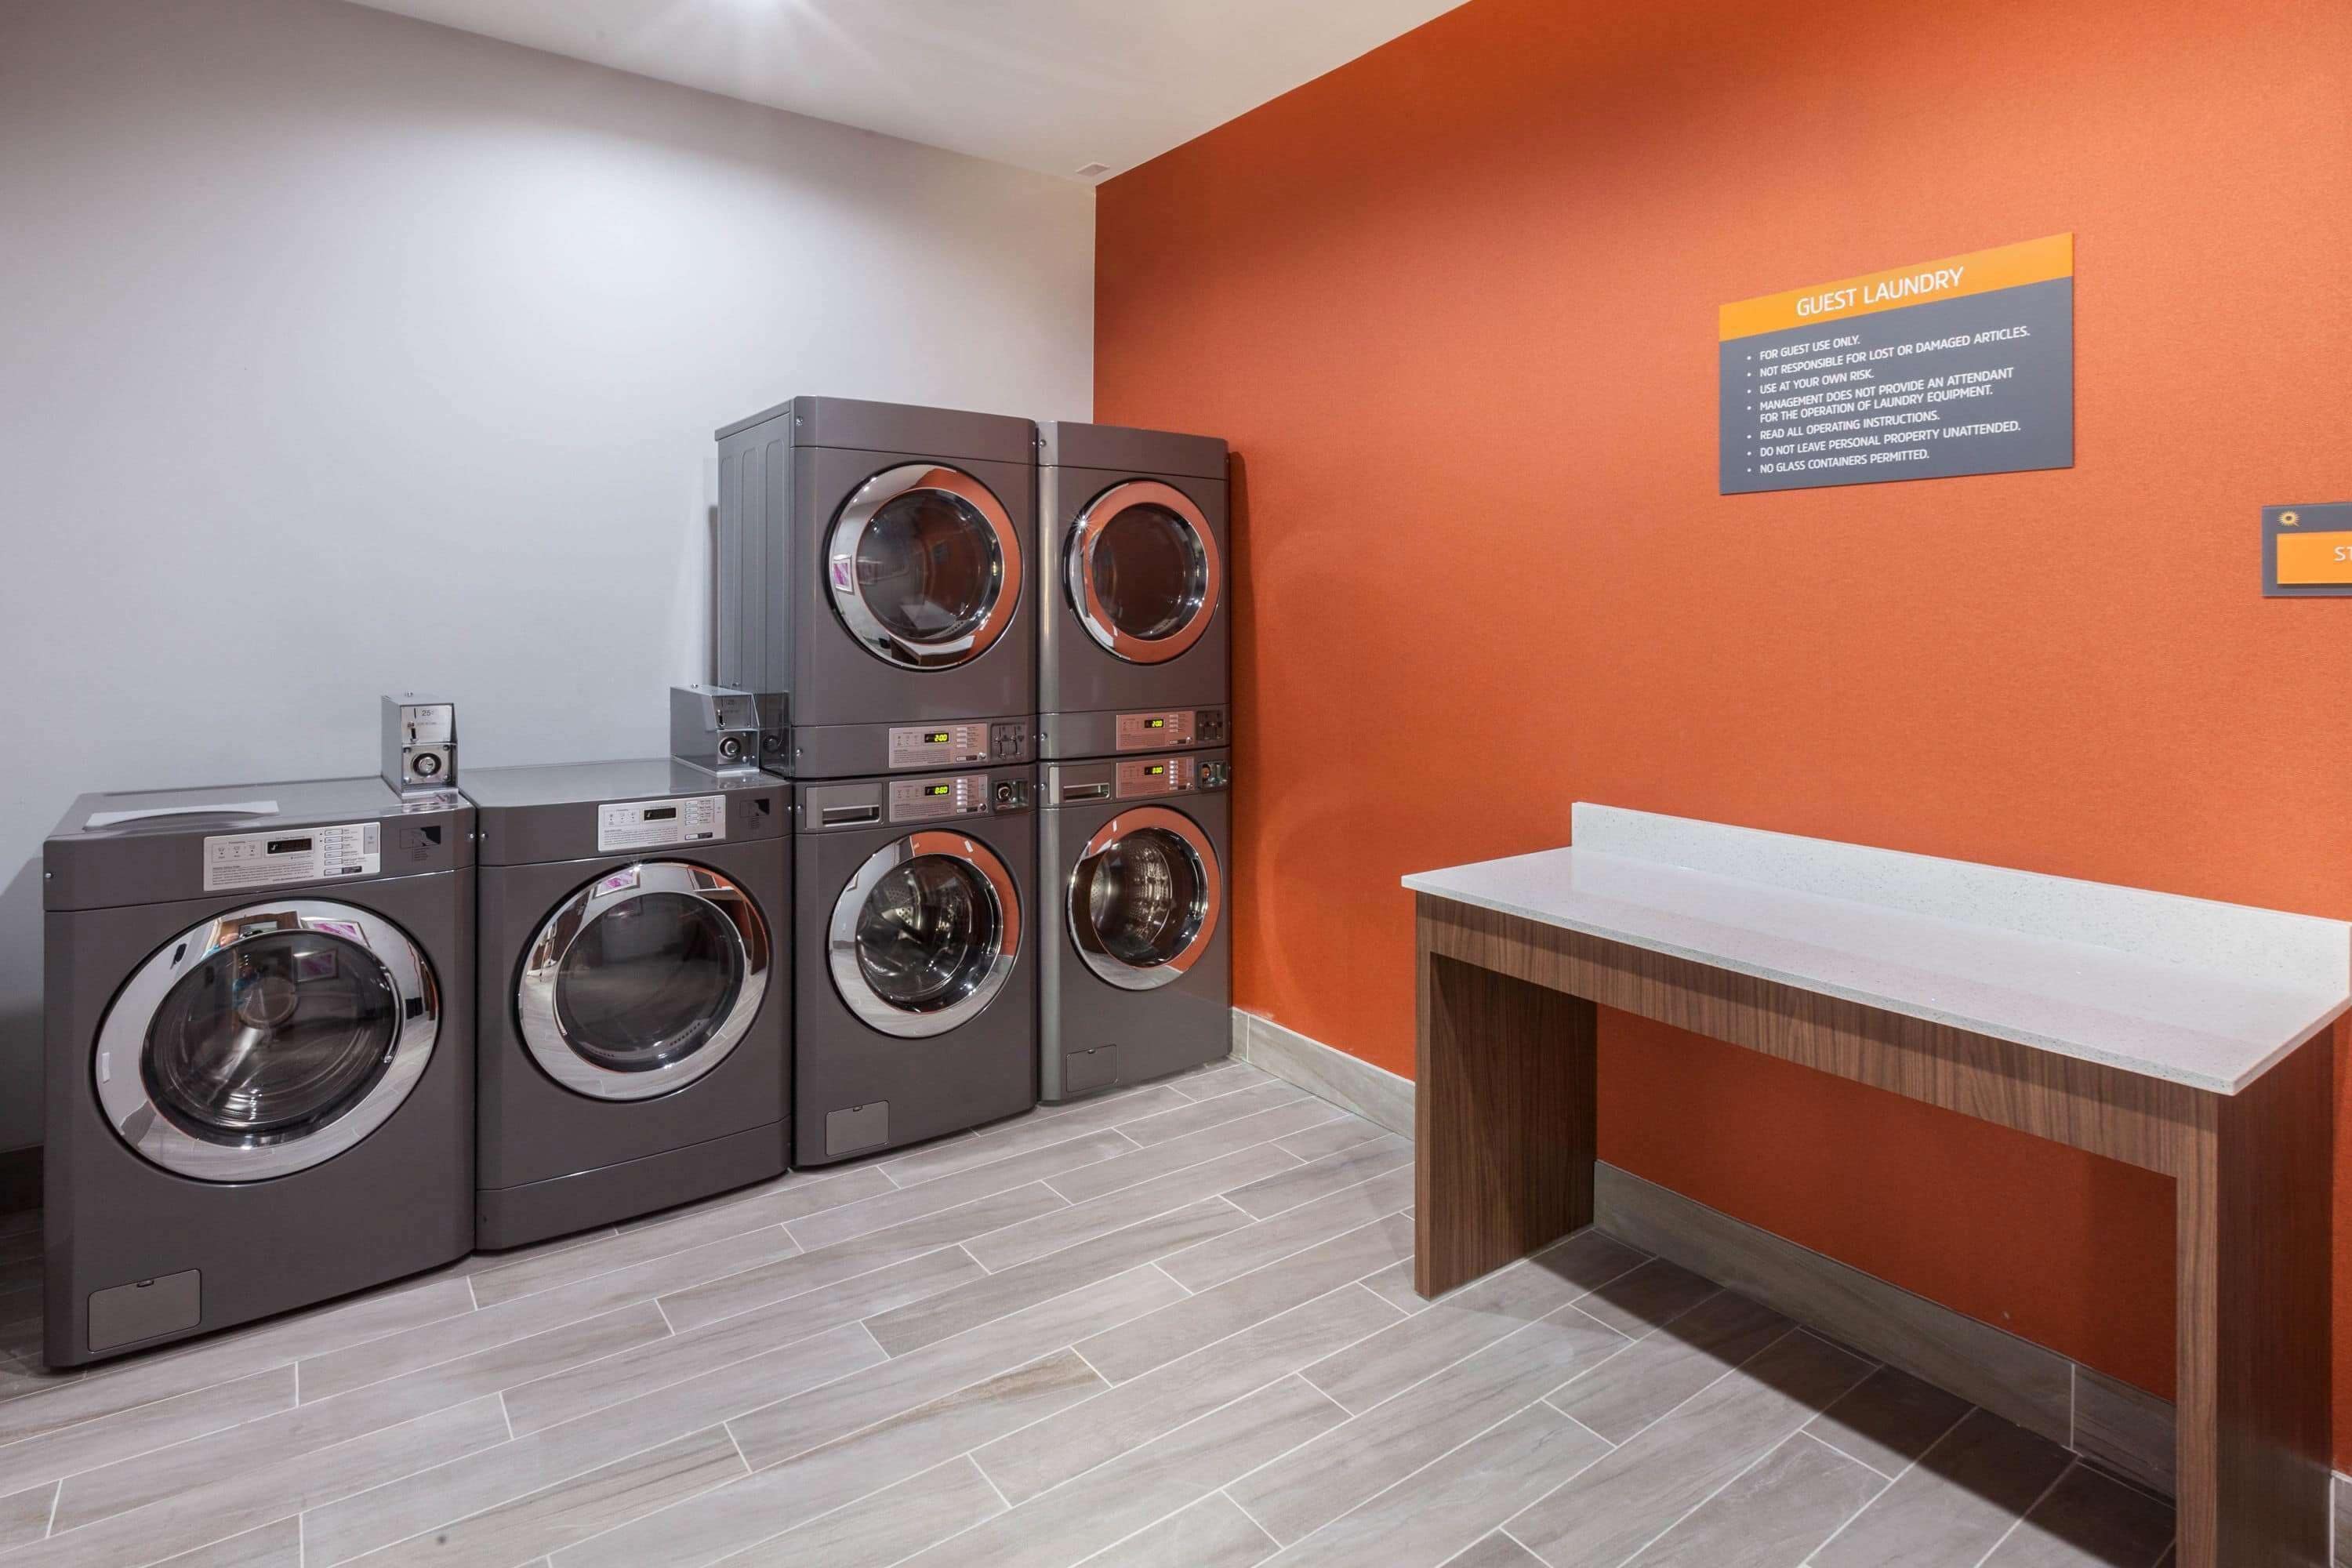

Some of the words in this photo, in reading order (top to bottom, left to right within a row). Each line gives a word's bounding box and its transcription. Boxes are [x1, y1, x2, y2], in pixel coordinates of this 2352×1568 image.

[1797, 289, 1857, 316] GUEST
[1864, 266, 1964, 304] LAUNDRY
[1760, 349, 1778, 360] FOR
[1780, 343, 1810, 357] GUEST
[1813, 339, 1831, 351] USE
[1833, 335, 1860, 348] ONLY.
[1760, 366, 1778, 377] NOT
[1781, 355, 1843, 374] RESPONSIBLE
[1846, 352, 1867, 364] FOR
[1869, 347, 1895, 360] LOST
[1897, 344, 1912, 356] OR
[1916, 336, 1970, 353] DAMAGED
[1973, 325, 2031, 344] ARTICLES.
[1760, 383, 1777, 394] USE
[1779, 381, 1791, 391] AT
[1793, 376, 1819, 390] YOUR
[1821, 373, 1847, 385] OWN
[1849, 368, 1874, 381] RISK.
[1760, 394, 1824, 411] MANAGEMENT
[1826, 390, 1853, 402] DOES
[1855, 387, 1876, 398] NOT
[1878, 379, 1924, 395] PROVIDE
[1927, 377, 1944, 389] AN
[1947, 367, 2014, 386] ATTENDANT
[1760, 413, 1778, 423] FOR
[1780, 410, 1798, 421] THE
[1801, 402, 1854, 418] OPERATION
[1857, 400, 1871, 411] OF
[1874, 394, 1924, 409] LAUNDRY
[1927, 385, 1993, 402] EQUIPMENT.
[1760, 429, 1784, 440] READ
[1787, 426, 1803, 437] ALL
[1806, 419, 1860, 434] OPERATING
[1863, 410, 1940, 429] INSTRUCTIONS.
[1760, 447, 1773, 457] DO
[1776, 445, 1795, 455] NOT
[1797, 441, 1826, 453] LEAVE
[1828, 436, 1881, 449] PERSONAL
[1884, 429, 1940, 445] PROPERTY
[1943, 420, 2021, 438] UNATTENDED.
[1760, 464, 1773, 474] NO
[1777, 461, 1805, 472] GLASS
[1808, 455, 1867, 469] CONTAINERS
[1870, 448, 1930, 464] PERMITTED.
